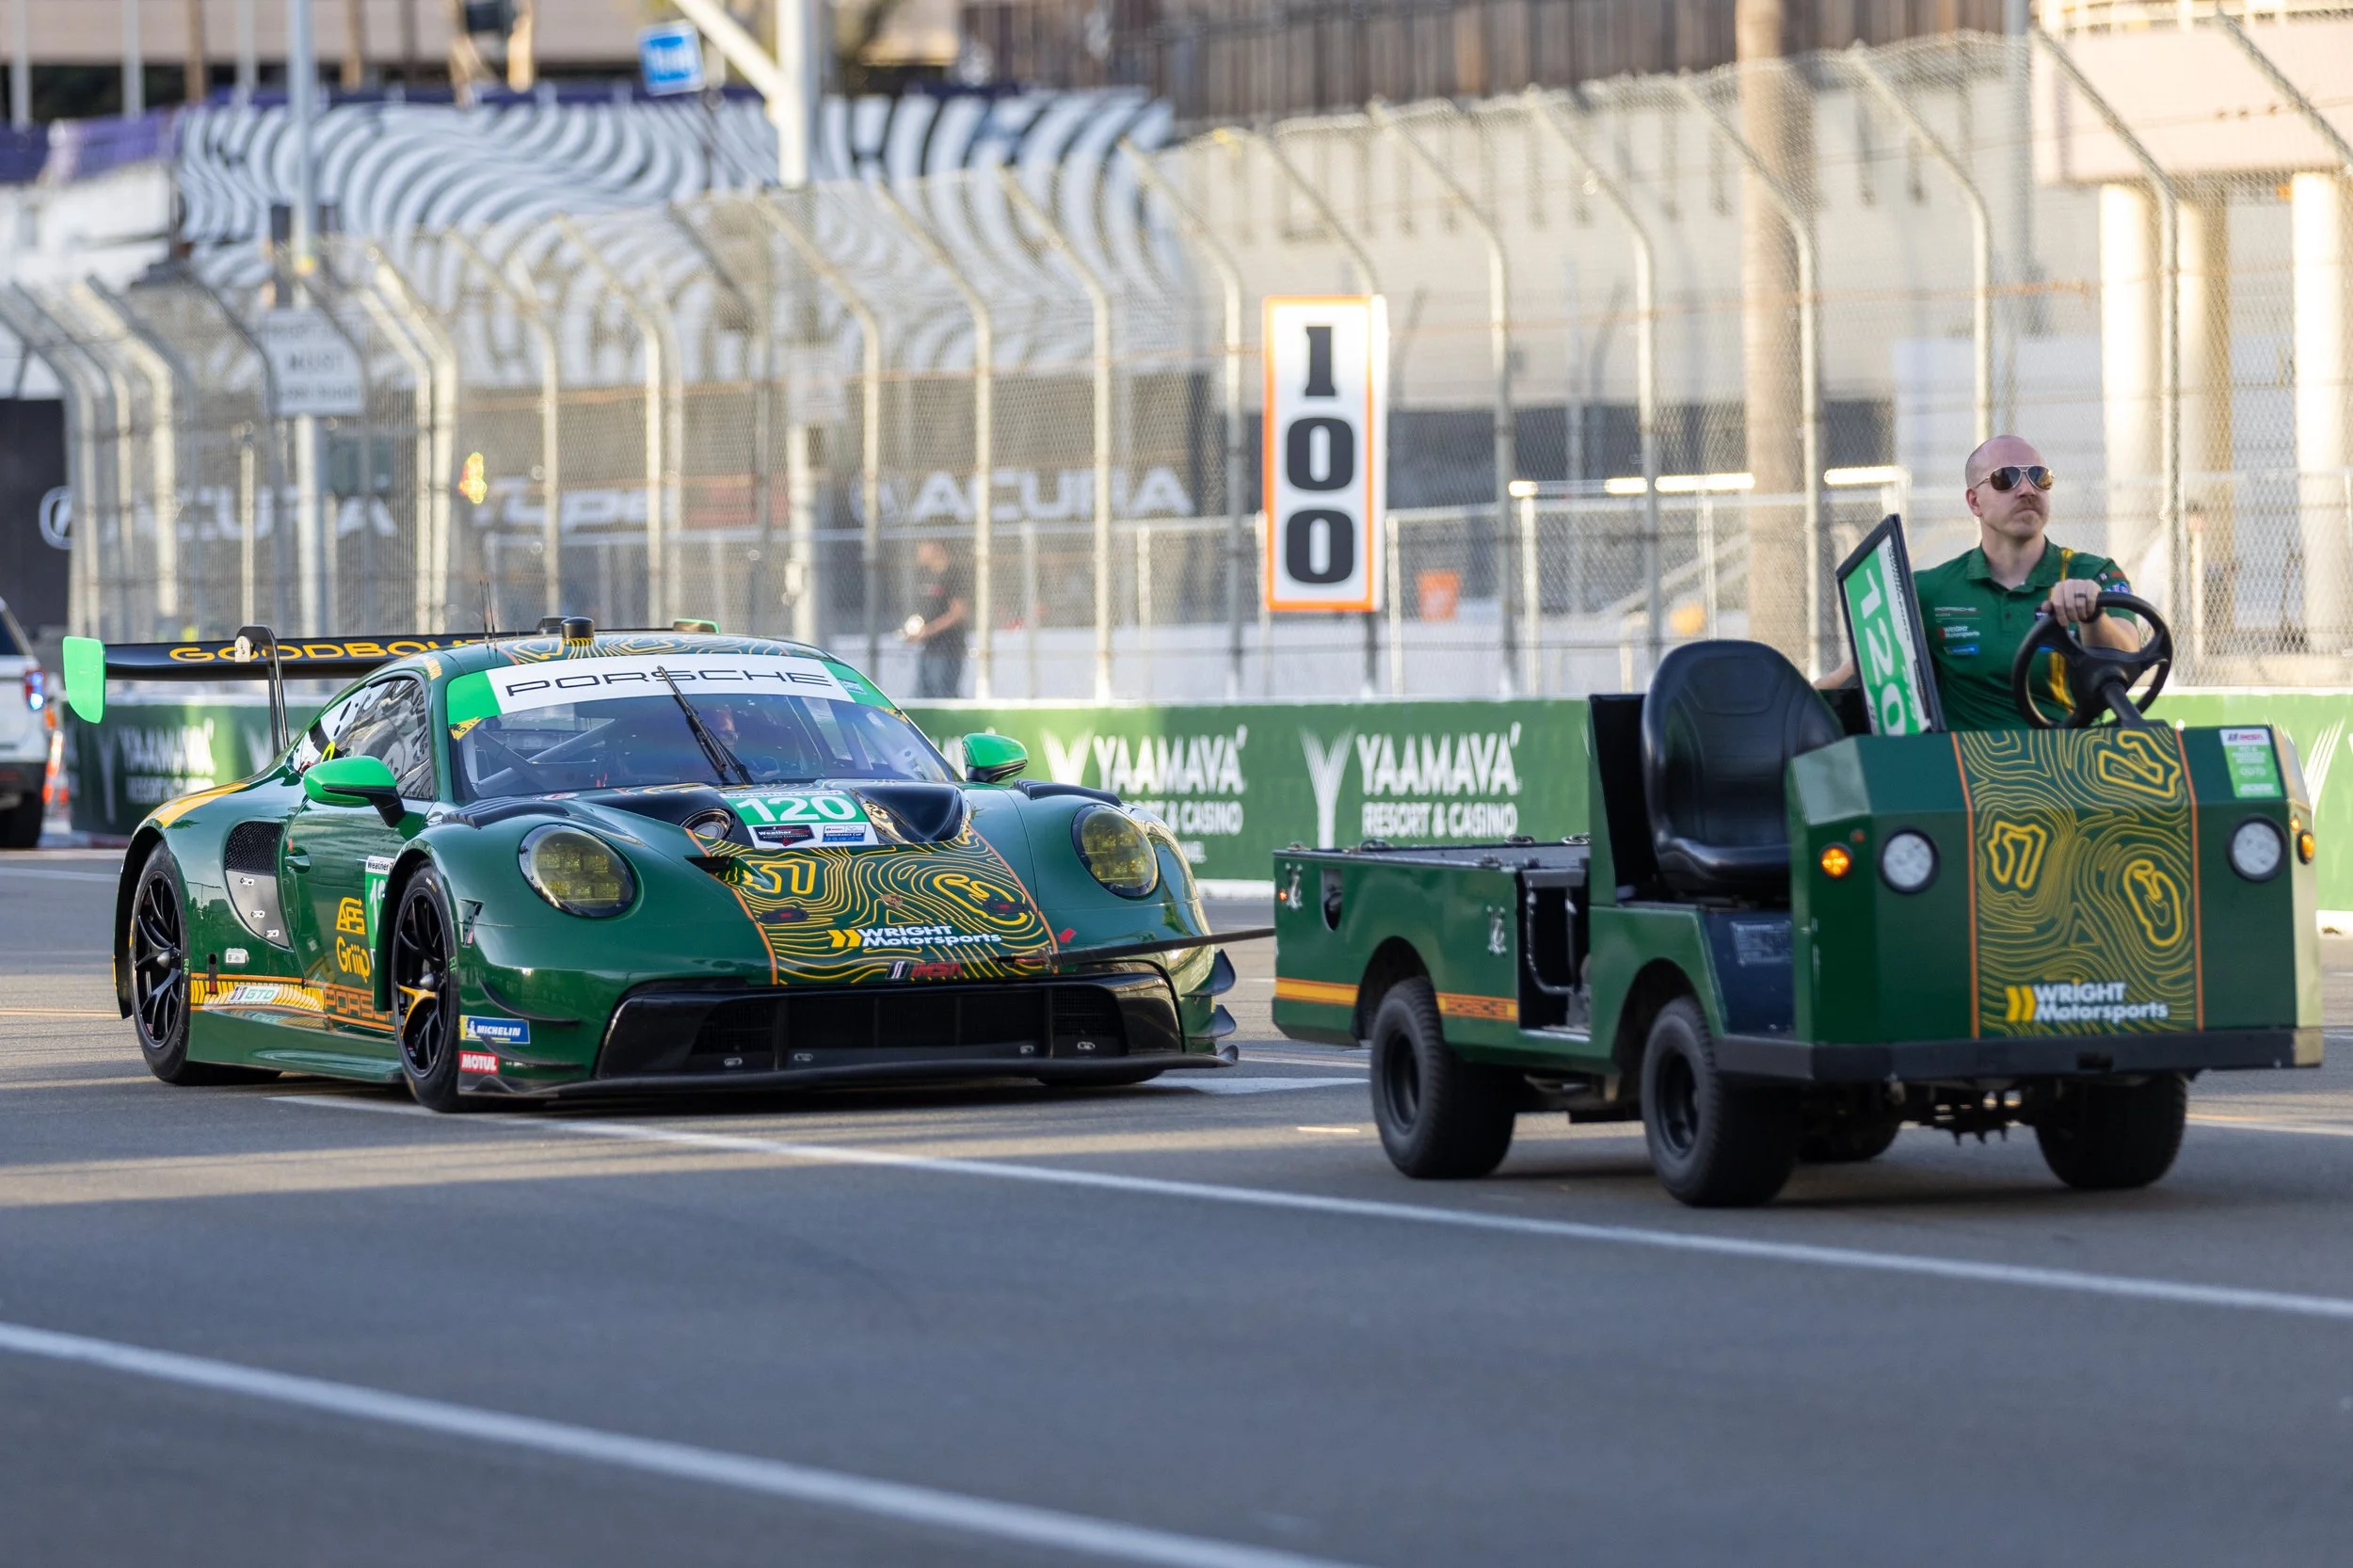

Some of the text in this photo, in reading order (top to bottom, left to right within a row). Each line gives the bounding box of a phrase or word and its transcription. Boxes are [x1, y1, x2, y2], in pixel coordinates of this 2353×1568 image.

[1286, 326, 1353, 584] 100
[102, 484, 396, 539] ACUA
[1860, 568, 1906, 735] 120
[505, 670, 832, 697] PORSCHE
[736, 795, 856, 822] 120
[1180, 801, 1243, 835] CASINO
[1362, 802, 1518, 838] RESORT & CASINO
[857, 924, 952, 937] WRIGHT
[861, 934, 1002, 947] Motorsports
[910, 961, 965, 978] IMSA
[245, 988, 275, 1000] GTD
[2033, 982, 2126, 1002] WRIGHT
[2033, 1000, 2169, 1026] Motorsports
[476, 1024, 521, 1037] MICHELIN
[461, 1054, 497, 1071] MOTUL
